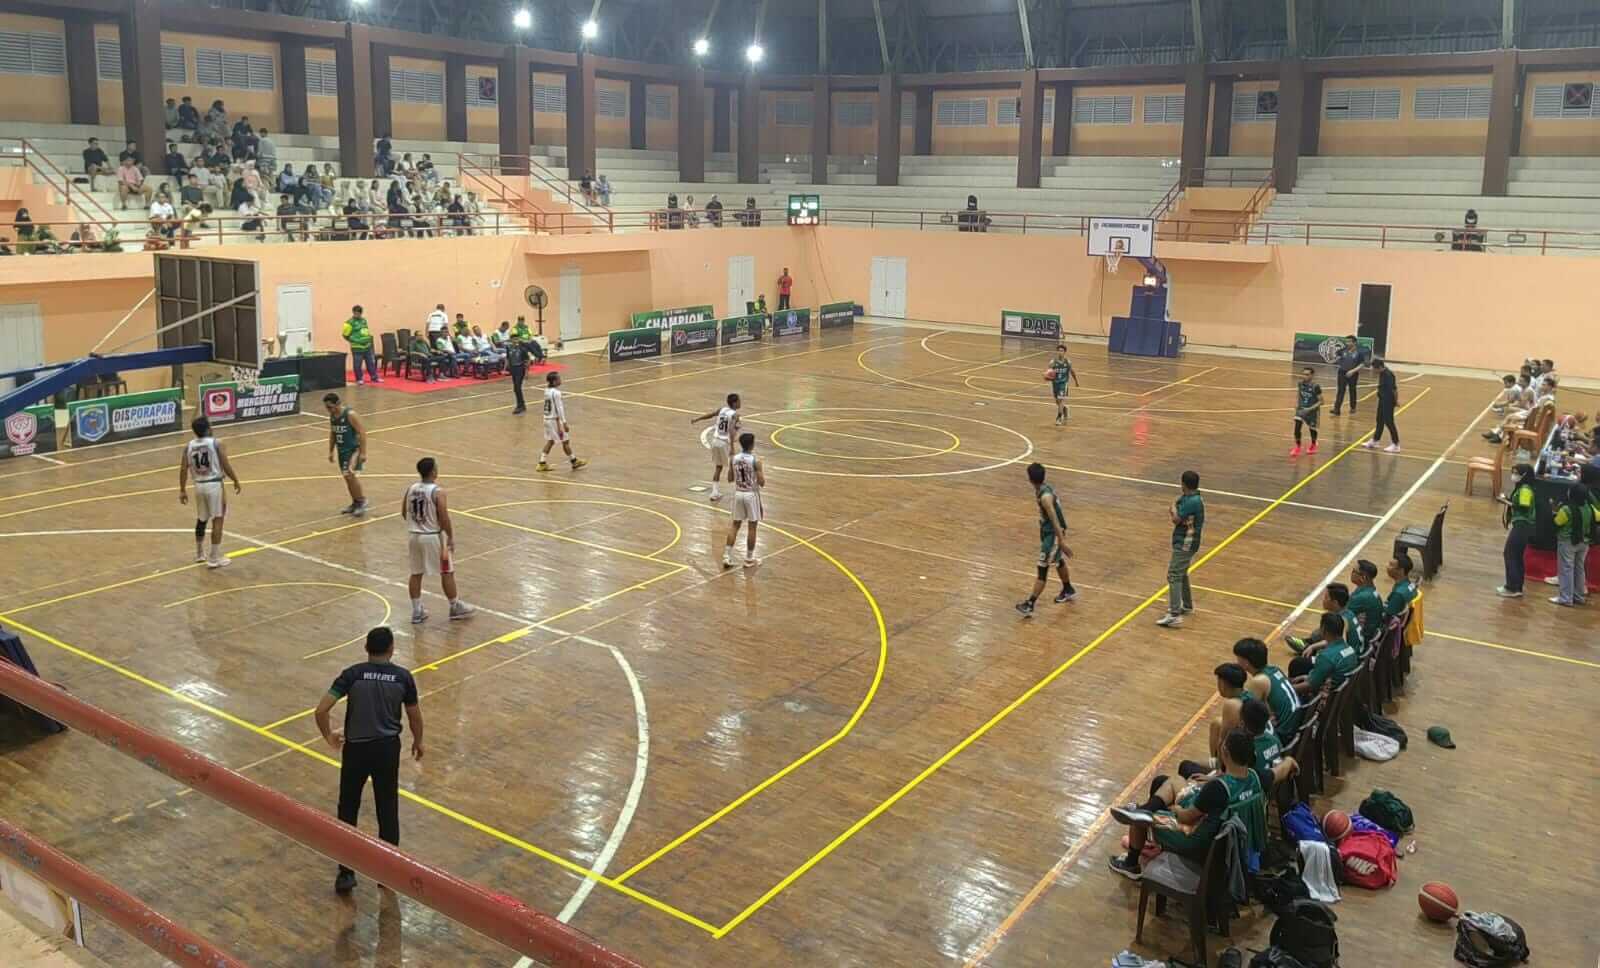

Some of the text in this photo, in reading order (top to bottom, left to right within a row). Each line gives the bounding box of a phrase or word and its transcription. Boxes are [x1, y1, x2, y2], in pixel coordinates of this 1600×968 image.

[646, 313, 704, 329] CHAMPION
[114, 403, 174, 423] DISPORAPAR
[193, 451, 209, 469] 14
[411, 498, 425, 519] 11
[1345, 855, 1379, 876] NIKE
